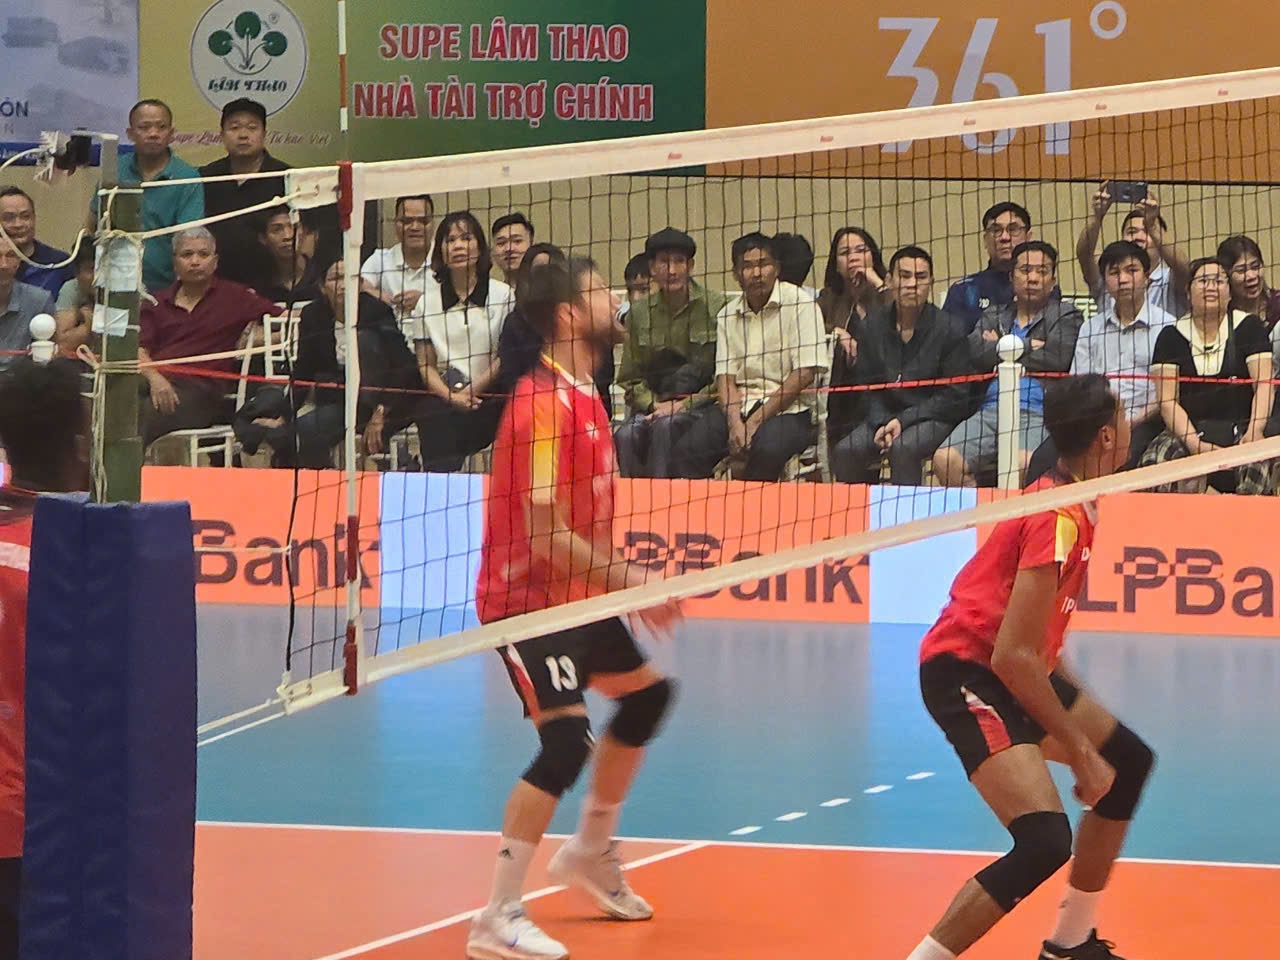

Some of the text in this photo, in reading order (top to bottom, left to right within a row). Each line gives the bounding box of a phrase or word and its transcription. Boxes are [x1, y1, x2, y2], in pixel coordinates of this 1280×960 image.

[379, 16, 629, 62] SUPE LÂM THAO
[353, 75, 654, 127] NHÀ TÀI TRỢ CHÍNH
